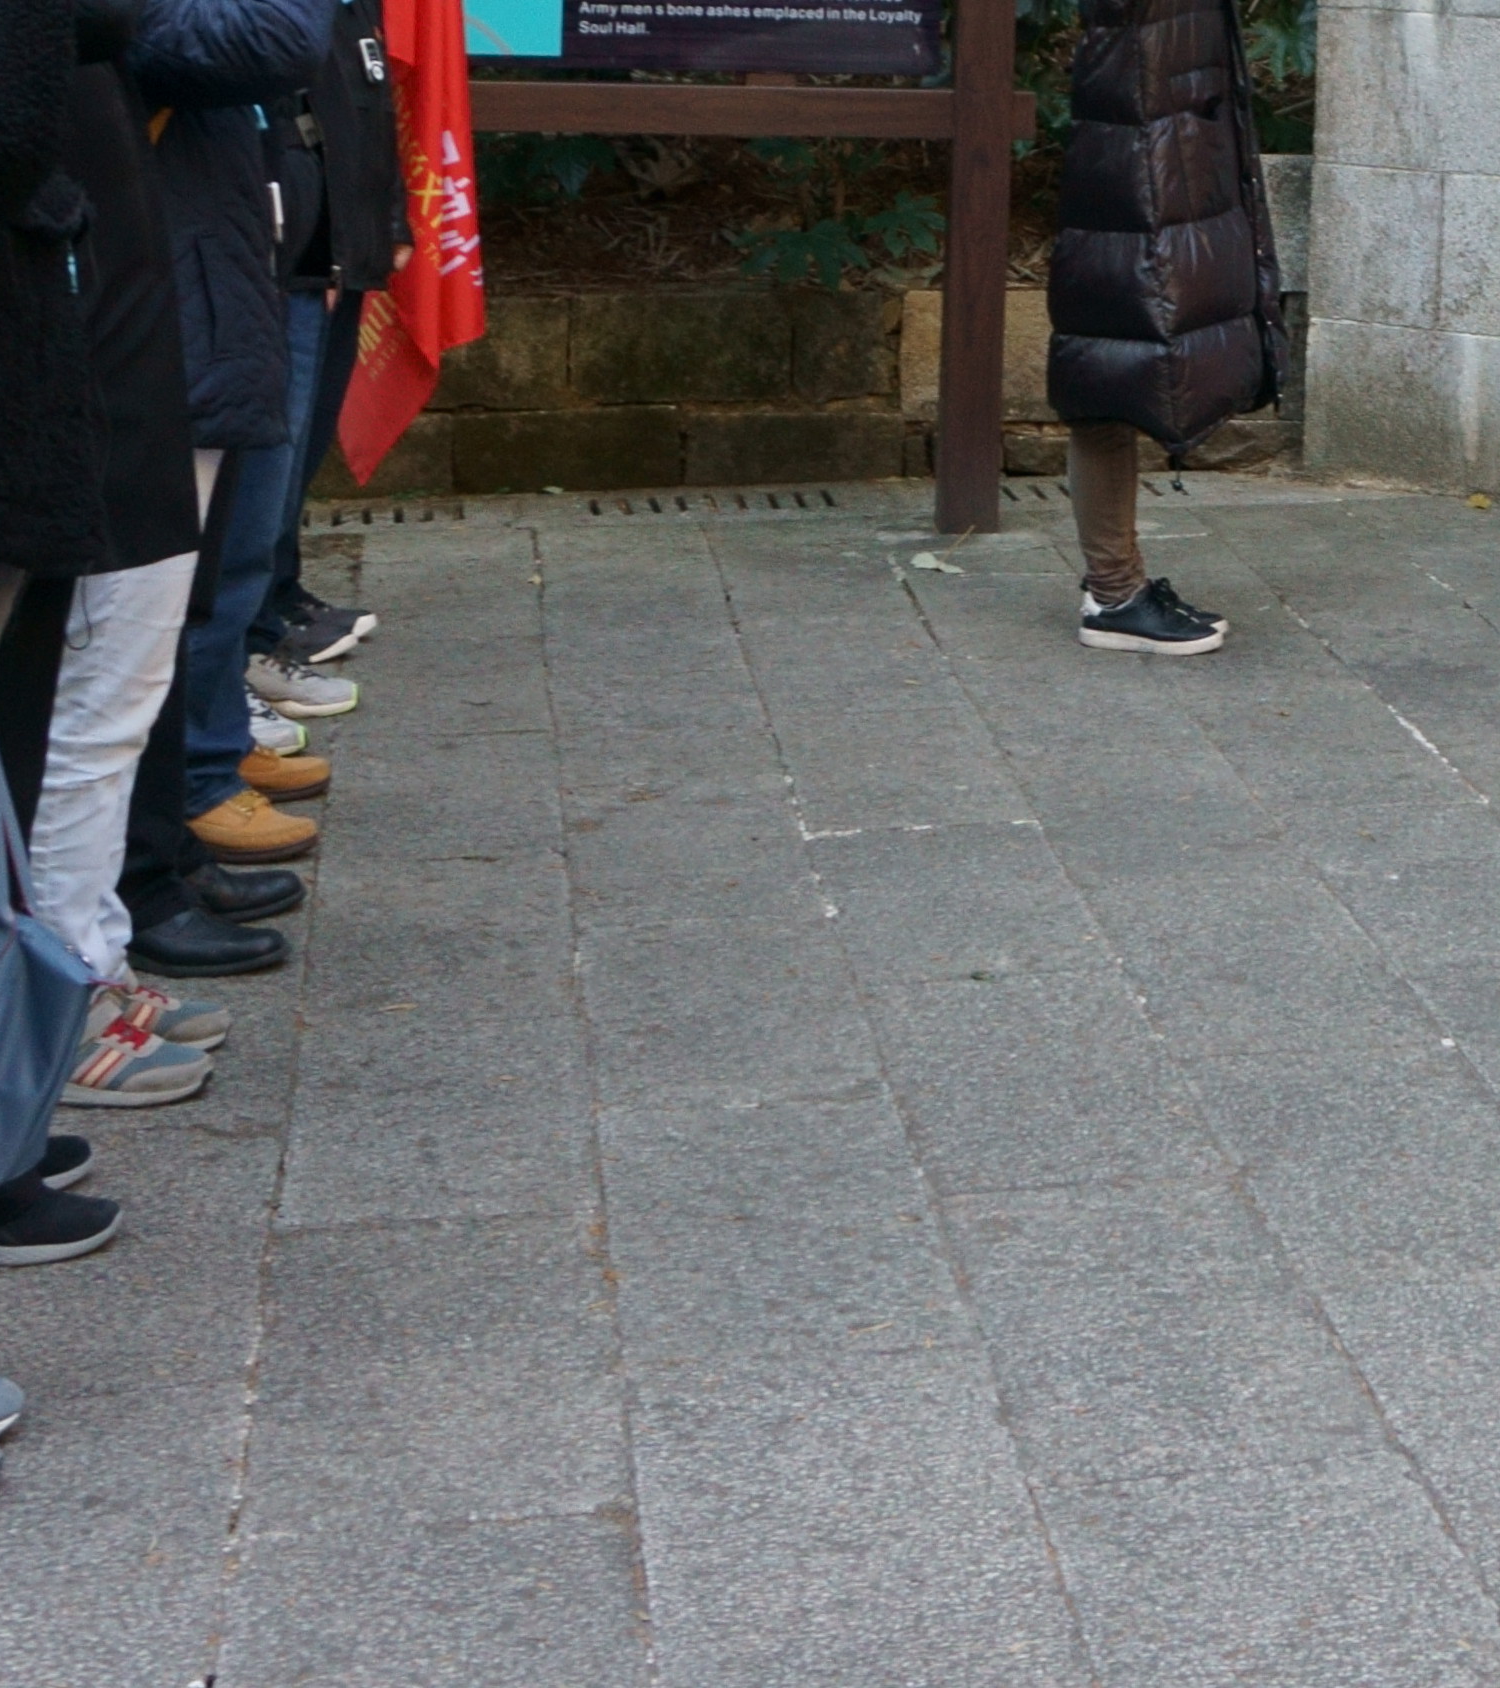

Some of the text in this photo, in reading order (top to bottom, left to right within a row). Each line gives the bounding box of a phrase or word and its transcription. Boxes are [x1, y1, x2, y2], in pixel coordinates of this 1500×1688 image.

[579, 2, 618, 17] Army
[667, 3, 703, 16] bone
[706, 5, 750, 17] ashes
[753, 6, 824, 20] emplaced
[827, 7, 840, 19] in
[843, 8, 867, 20] the
[869, 9, 922, 24] Loyalty
[579, 20, 613, 34] Soul
